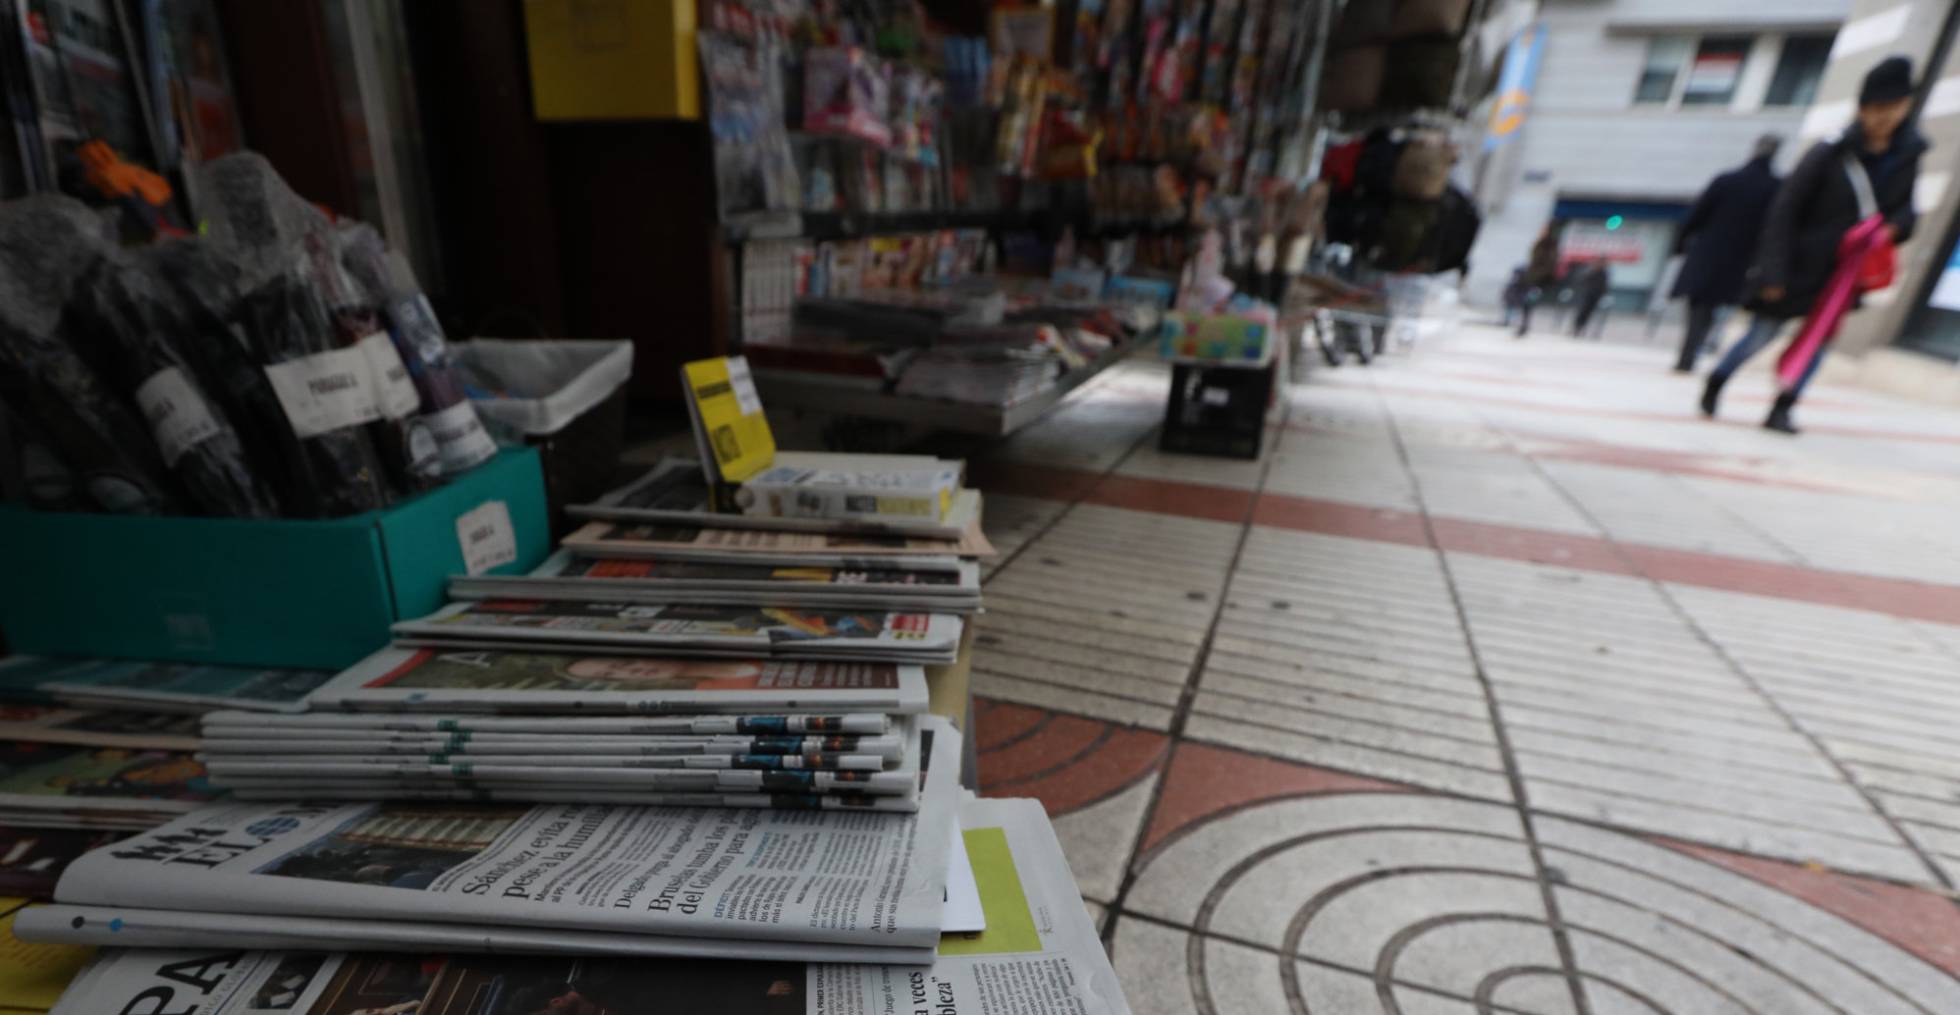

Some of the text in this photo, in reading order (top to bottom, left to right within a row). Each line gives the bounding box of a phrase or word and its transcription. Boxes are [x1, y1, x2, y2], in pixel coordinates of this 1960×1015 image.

[461, 849, 540, 895] Sánchez
[530, 820, 571, 850] evita
[725, 832, 750, 855] para
[502, 867, 542, 899] pese
[647, 868, 698, 913] Bruselas
[704, 825, 730, 841] los
[688, 855, 736, 889] Gobierno
[676, 891, 706, 916] del
[908, 971, 928, 1005] veces
